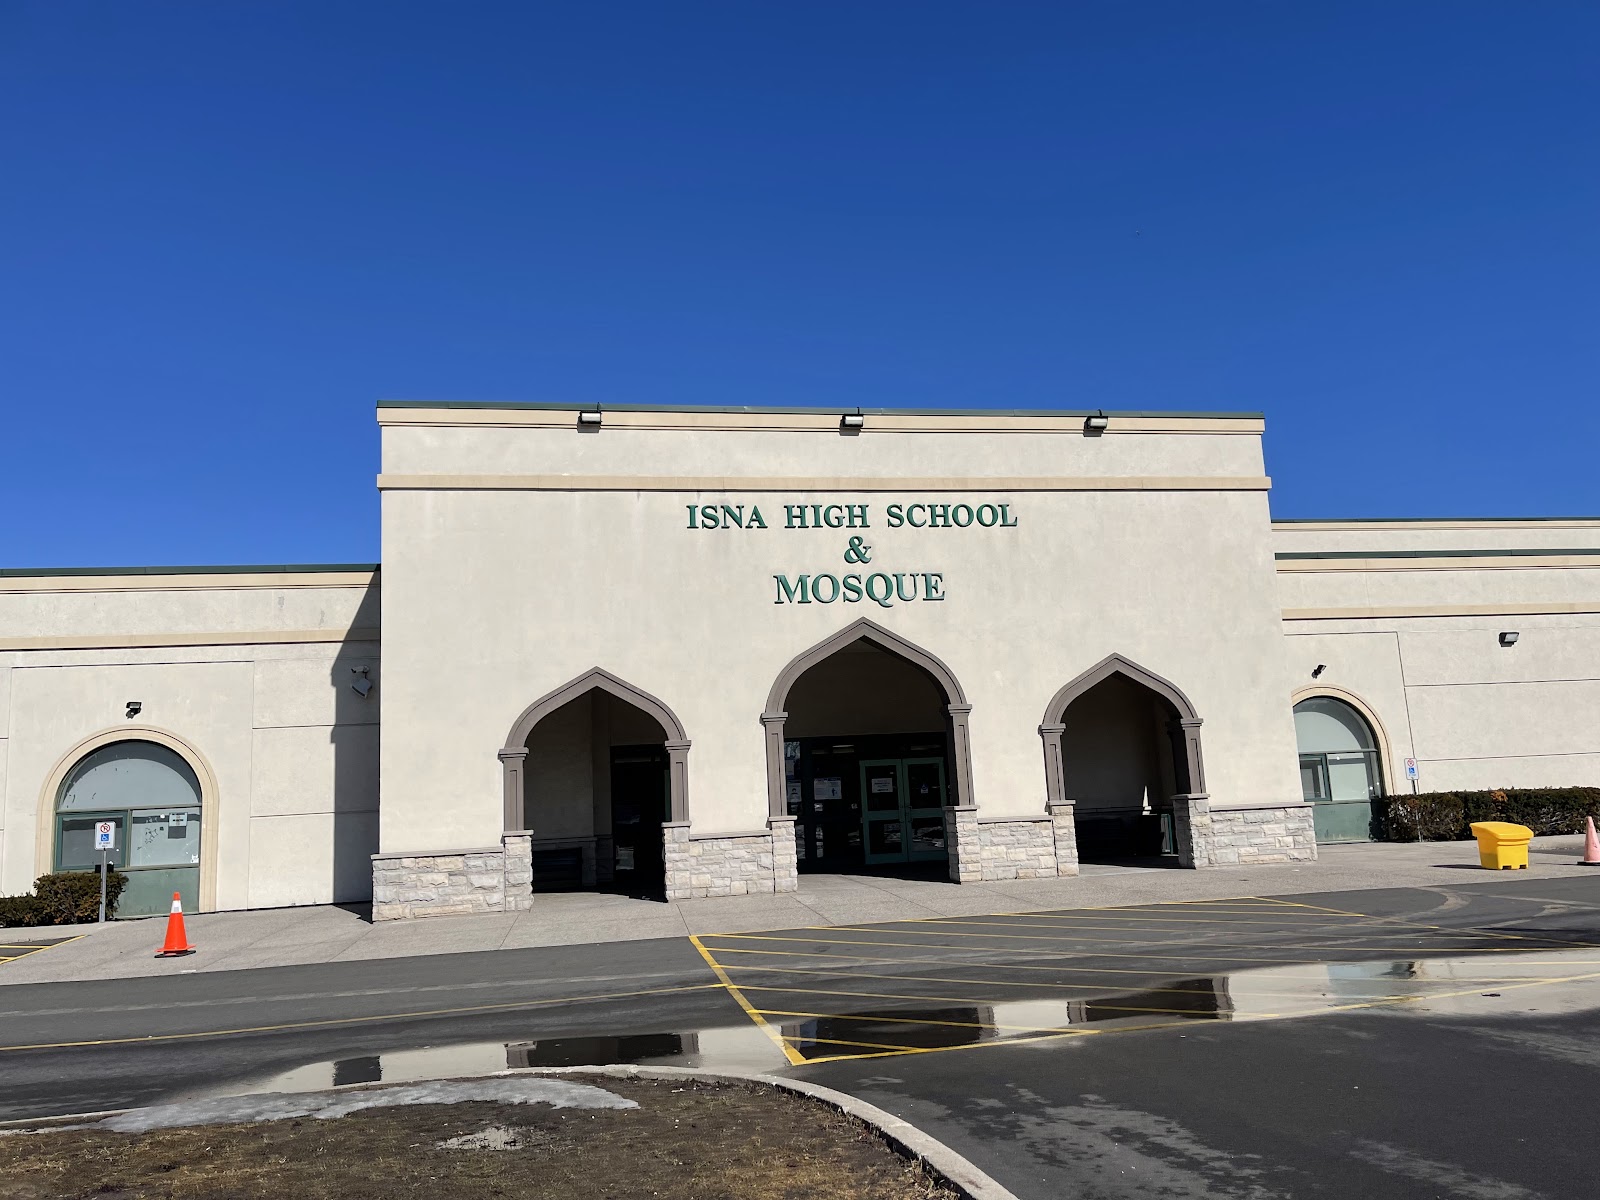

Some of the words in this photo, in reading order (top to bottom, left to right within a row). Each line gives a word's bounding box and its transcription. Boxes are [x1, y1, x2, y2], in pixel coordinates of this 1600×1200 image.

[686, 504, 768, 530] ISNA
[784, 504, 870, 529] HIGH
[887, 503, 1017, 528] SCHOOL
[844, 535, 871, 564] &
[773, 572, 945, 608] MOSQUE
